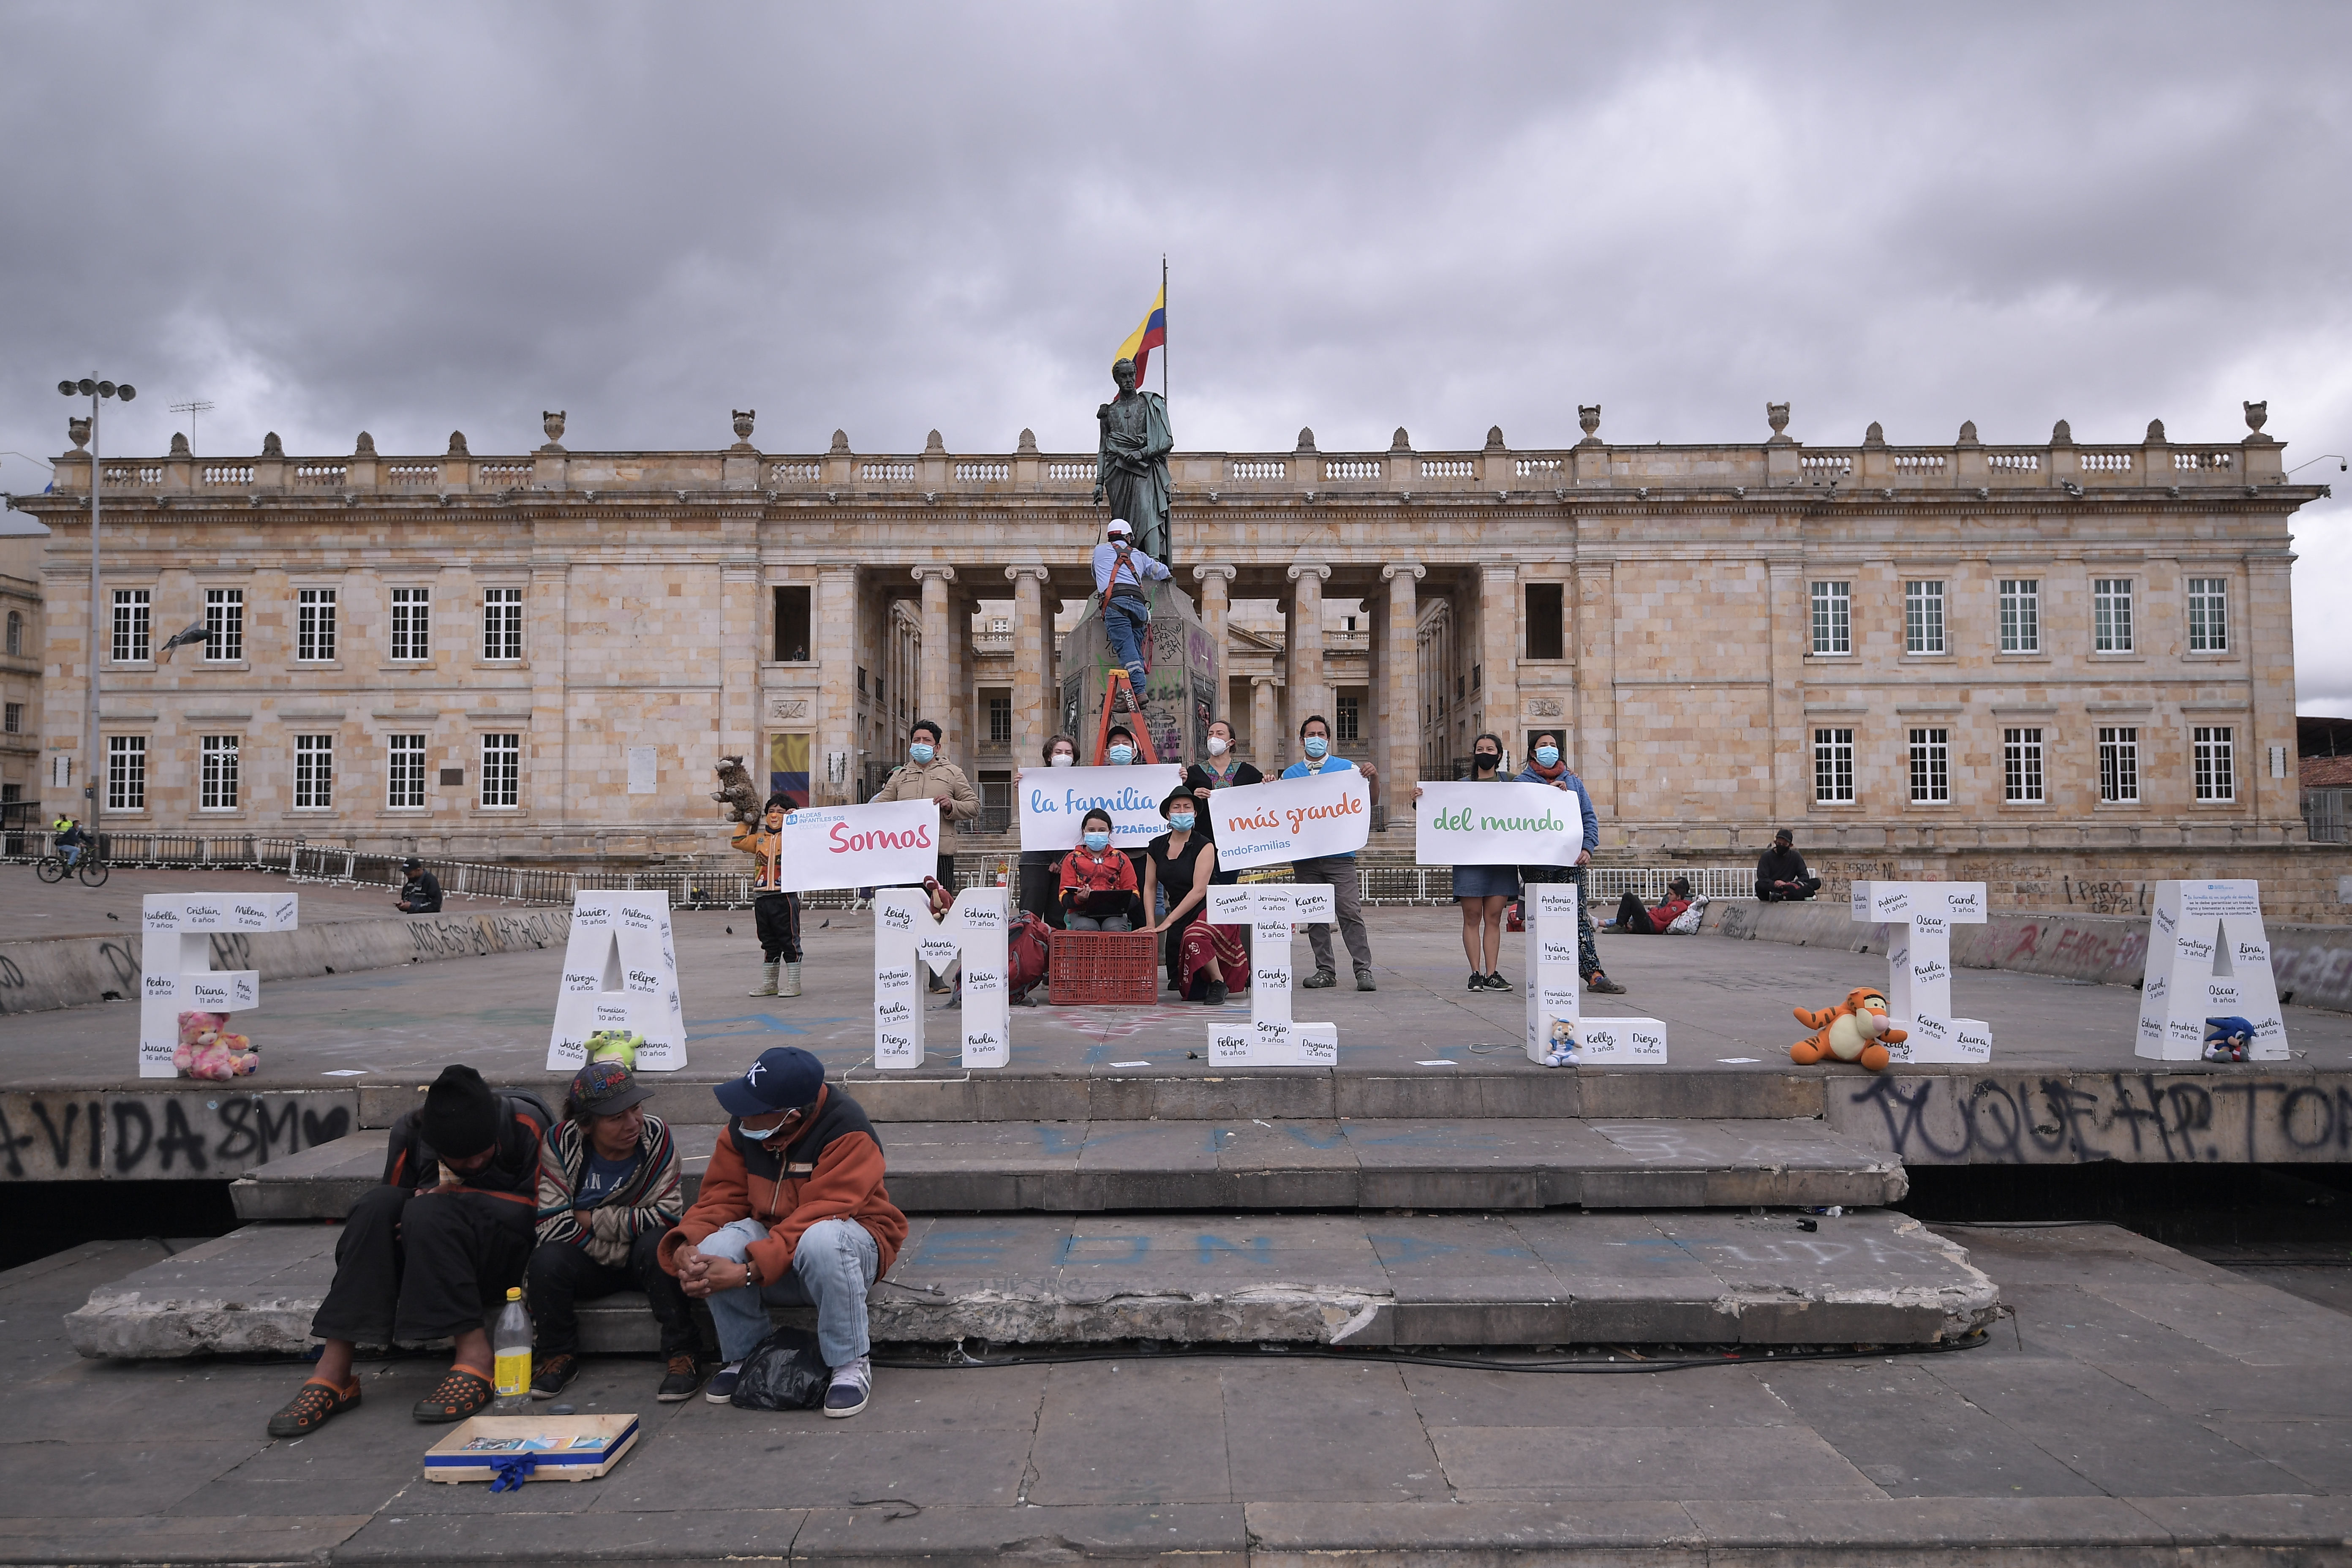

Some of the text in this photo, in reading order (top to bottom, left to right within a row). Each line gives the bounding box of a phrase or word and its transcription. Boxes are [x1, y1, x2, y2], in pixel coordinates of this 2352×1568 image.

[1031, 787, 1157, 815] la familia
[1228, 792, 1362, 834] más grande
[1433, 806, 1564, 831] del mundo
[829, 822, 931, 853] Somos
[1221, 840, 1291, 857] endoFamilias
[1883, 862, 1895, 880] NO
[1216, 891, 1251, 906] Samuel,
[1258, 895, 1290, 903] Jerónimo,
[1295, 895, 1327, 907] Karen,
[1541, 895, 1574, 905] Antonio,
[1878, 893, 1908, 908] Adrian,
[1948, 894, 1978, 906] Carol,
[186, 906, 221, 915] Cristián,
[235, 905, 267, 919] Milena,
[576, 907, 610, 918] Javier,
[1230, 904, 1247, 914] años
[1308, 905, 1325, 913] años
[1892, 902, 1908, 912] años
[144, 911, 180, 921] Isabella,
[621, 908, 654, 922] Milena,
[884, 906, 913, 924] Leidy,
[964, 907, 999, 920] Edwin,
[631, 921, 648, 929] años
[892, 922, 909, 930] años
[1257, 921, 1288, 931] Nicolás,
[1916, 914, 1946, 928] Oscar,
[921, 938, 956, 949] Juana,
[2177, 938, 2214, 953] Santiago,
[2239, 942, 2264, 954] Lina,
[2189, 950, 2207, 958] años
[1914, 961, 1945, 976] Paula,
[565, 973, 598, 985] Mireya,
[879, 970, 912, 981] Antonio,
[969, 971, 997, 983] Luisa,
[1258, 968, 1290, 983] Cindy,
[1928, 972, 1945, 981] años
[146, 977, 174, 988] Pedro,
[237, 980, 252, 994] Ana,
[2147, 977, 2166, 992] Carol,
[195, 985, 228, 996] Diana,
[637, 985, 655, 993] años
[2208, 985, 2239, 996] Oscar,
[879, 1002, 910, 1015] Paula,
[1257, 1021, 1290, 1037] Sergio,
[1917, 1014, 1947, 1034] Karen,
[2141, 1017, 2162, 1032] Edwin,
[2170, 1021, 2201, 1034] Andrés,
[968, 1033, 997, 1045] Paola,
[1586, 1031, 1616, 1047] Kelly,
[1632, 1033, 1661, 1048] Diego,
[1925, 1029, 1941, 1040] años
[1957, 1032, 1989, 1048] Laura,
[2180, 1032, 2197, 1041] años
[560, 1037, 583, 1053] José,
[882, 1034, 910, 1048] Diego,
[1302, 1039, 1336, 1051] Dayana,
[566, 1051, 583, 1060] años
[31, 1098, 207, 1172] VIDA
